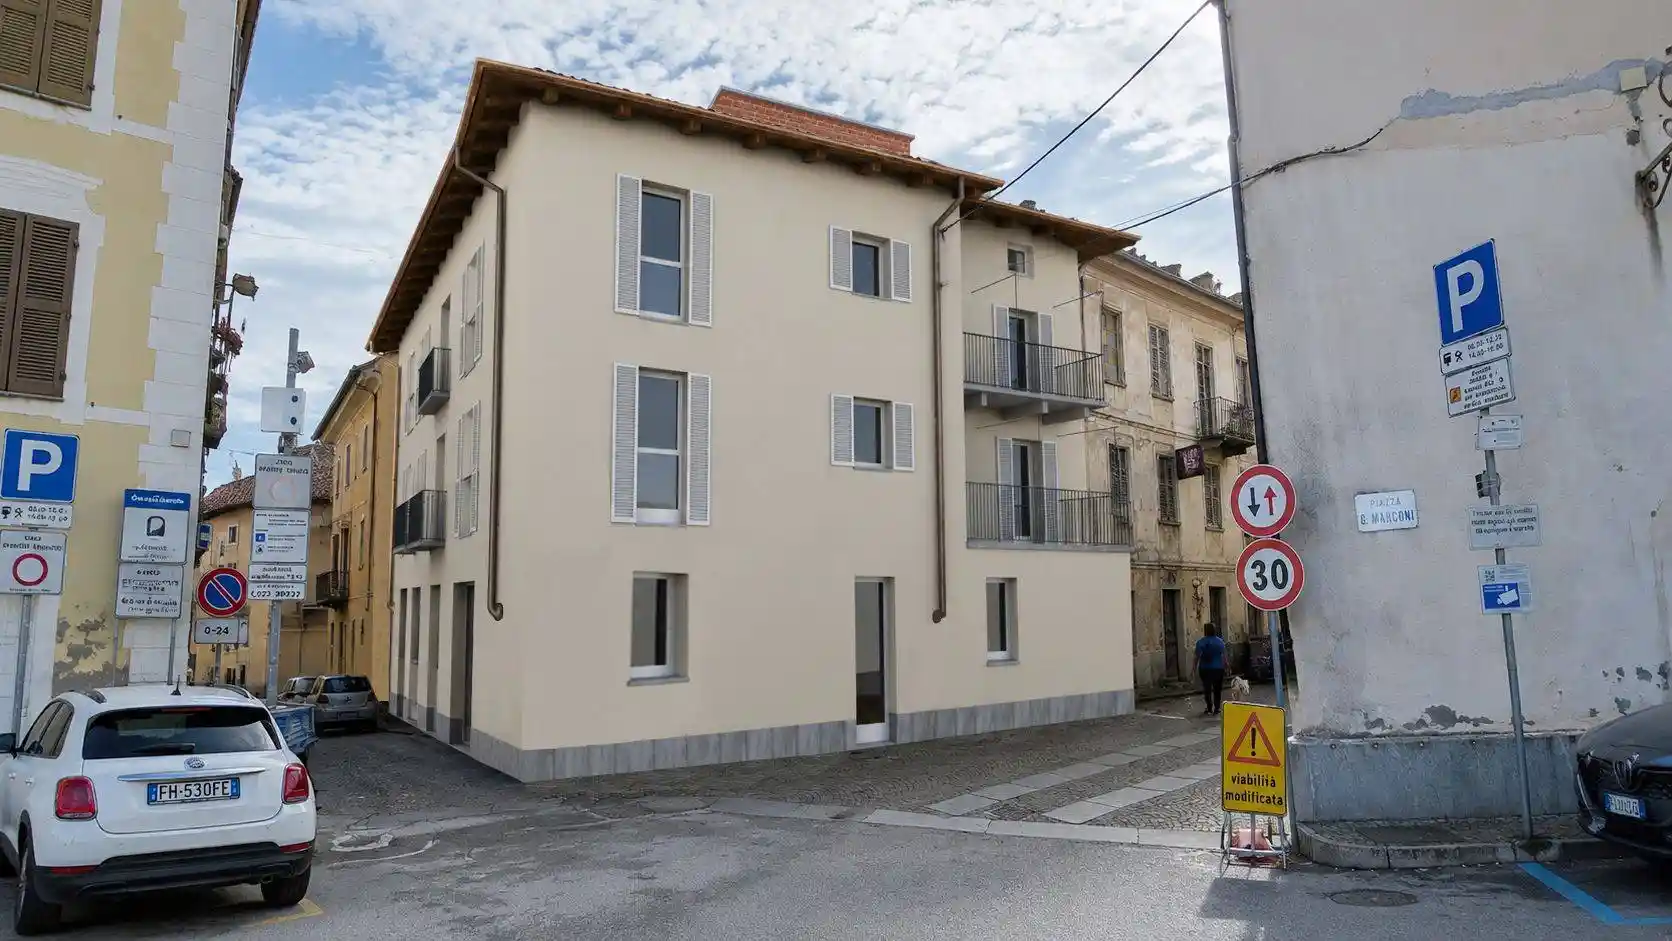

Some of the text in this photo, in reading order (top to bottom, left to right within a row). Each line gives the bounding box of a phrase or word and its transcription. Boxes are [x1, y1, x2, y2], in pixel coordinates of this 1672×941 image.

[1446, 259, 1484, 333] P
[17, 438, 63, 492] P
[1370, 497, 1402, 507] PIAZZA
[1371, 509, 1414, 524] MARCONI
[1251, 559, 1288, 591] 30
[204, 626, 229, 636] 0-24
[1225, 790, 1283, 806] modificata
